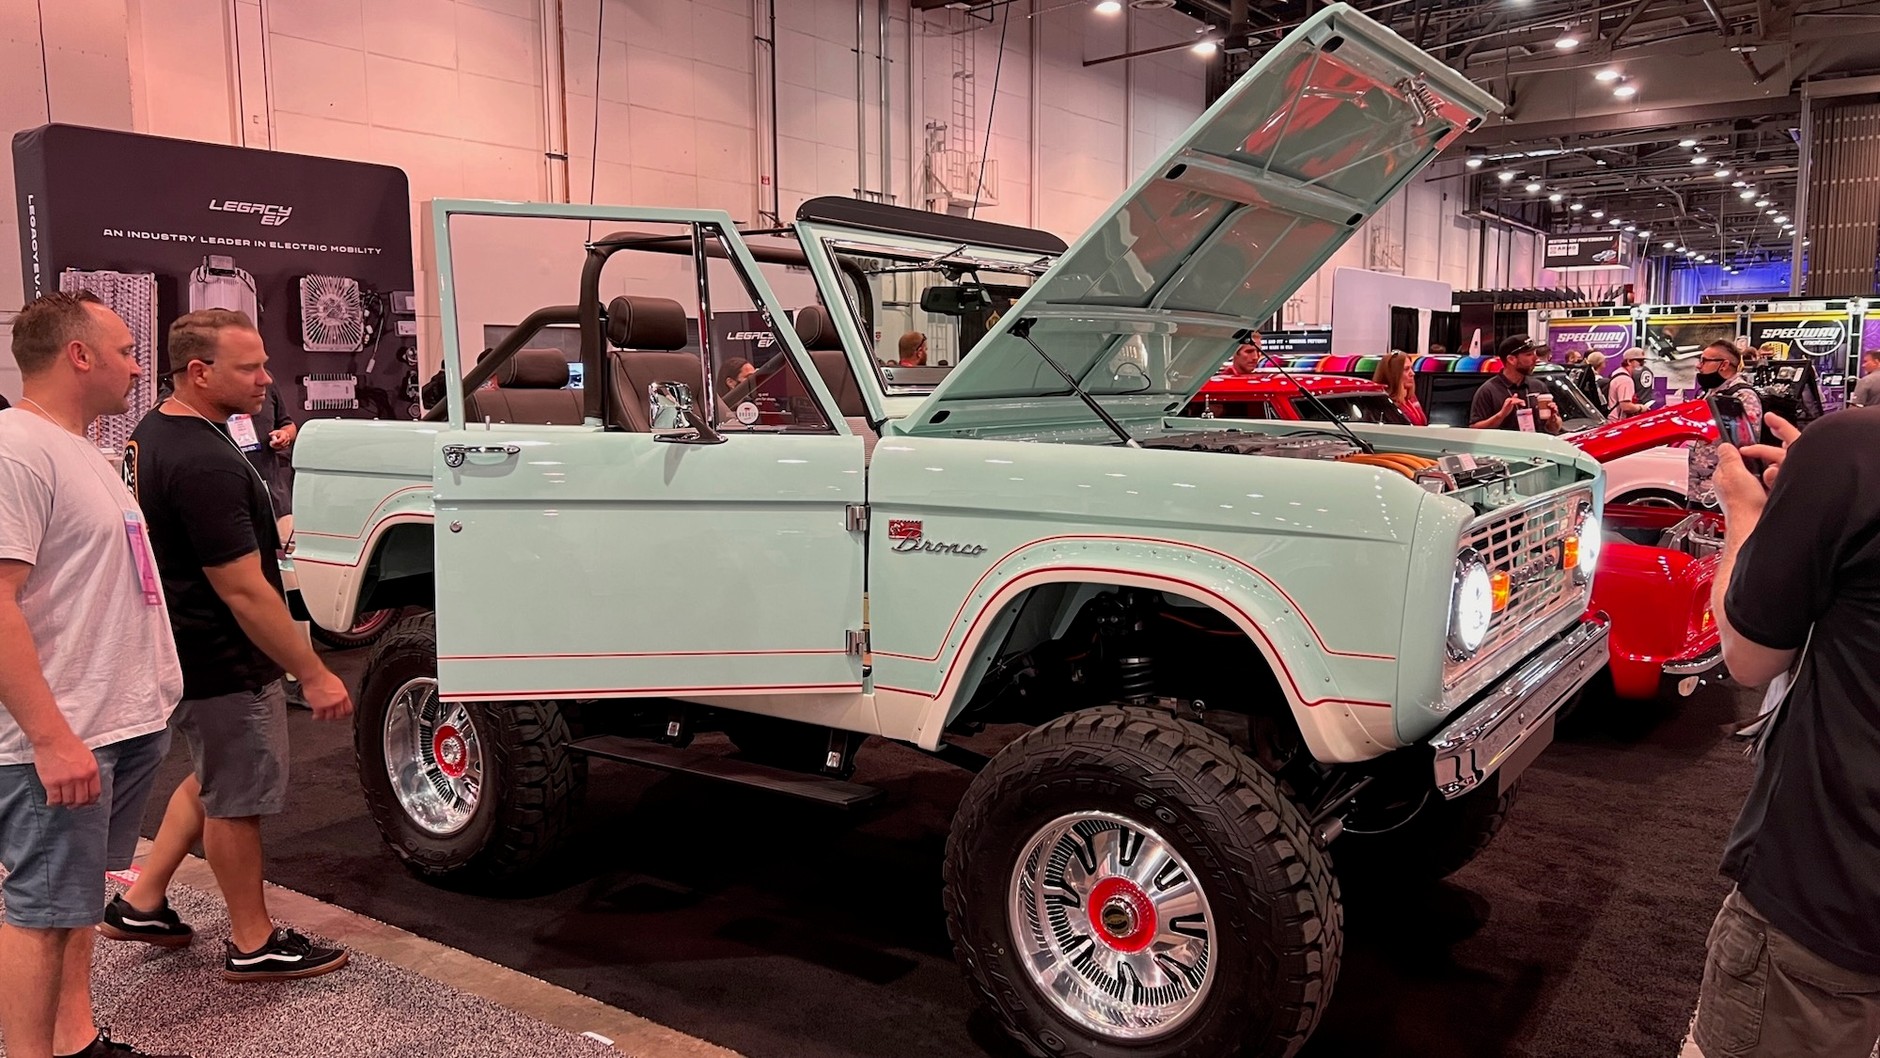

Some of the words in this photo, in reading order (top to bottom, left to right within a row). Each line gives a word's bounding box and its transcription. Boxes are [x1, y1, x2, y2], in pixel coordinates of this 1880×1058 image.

[208, 199, 293, 217] LEGACY
[260, 214, 290, 226] EV
[103, 228, 123, 237] AN
[127, 230, 197, 243] INDUSTRY
[200, 236, 251, 247] LEADER
[254, 240, 267, 248] IN
[269, 241, 328, 252] ELECTRIC
[330, 245, 382, 255] MOBILITY
[1556, 331, 1626, 343] SPEEDWAY
[1760, 327, 1842, 340] SPEEDWAY
[757, 339, 775, 348] EV
[890, 527, 988, 556] Bronco
